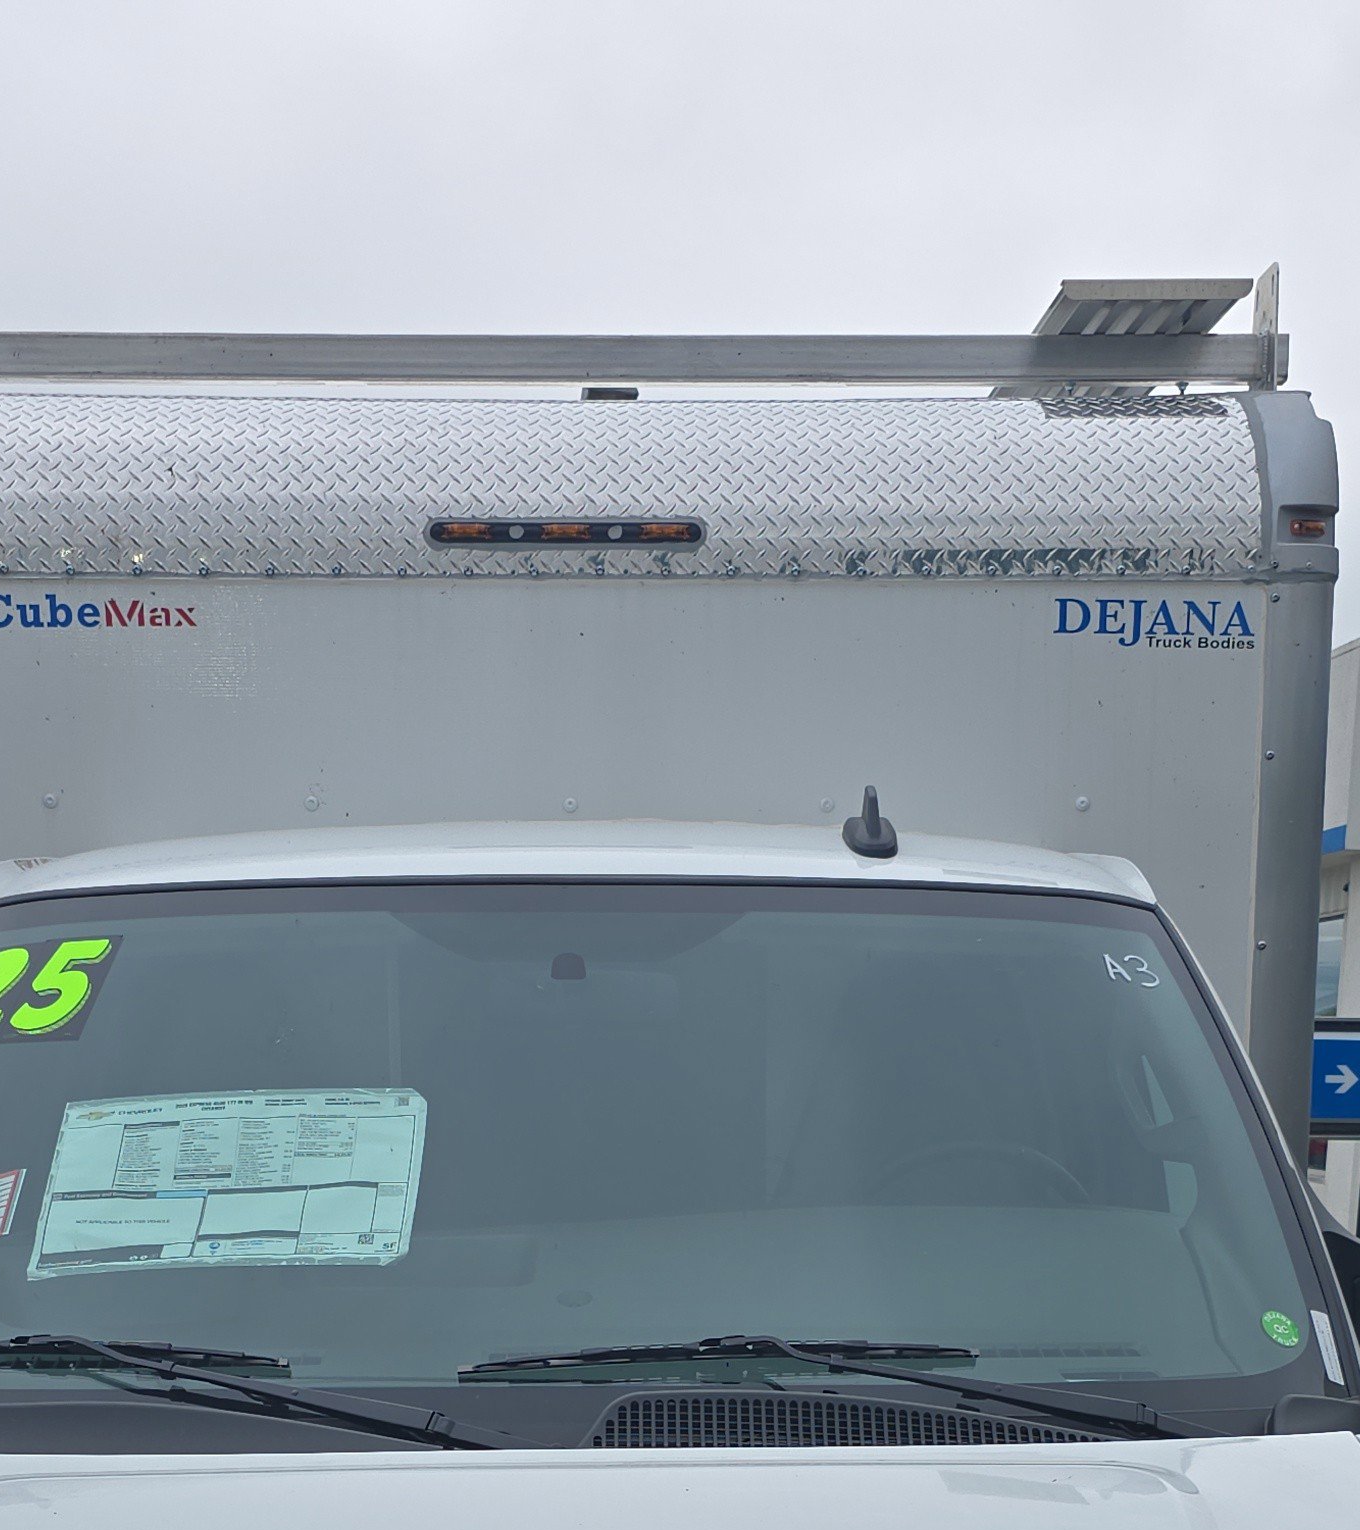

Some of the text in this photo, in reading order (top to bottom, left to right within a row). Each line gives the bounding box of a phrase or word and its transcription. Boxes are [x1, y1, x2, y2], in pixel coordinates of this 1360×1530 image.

[1053, 598, 1255, 647] DEJANA
[1146, 635, 1255, 650] Truck Bodies
[1103, 953, 1160, 988] A3
